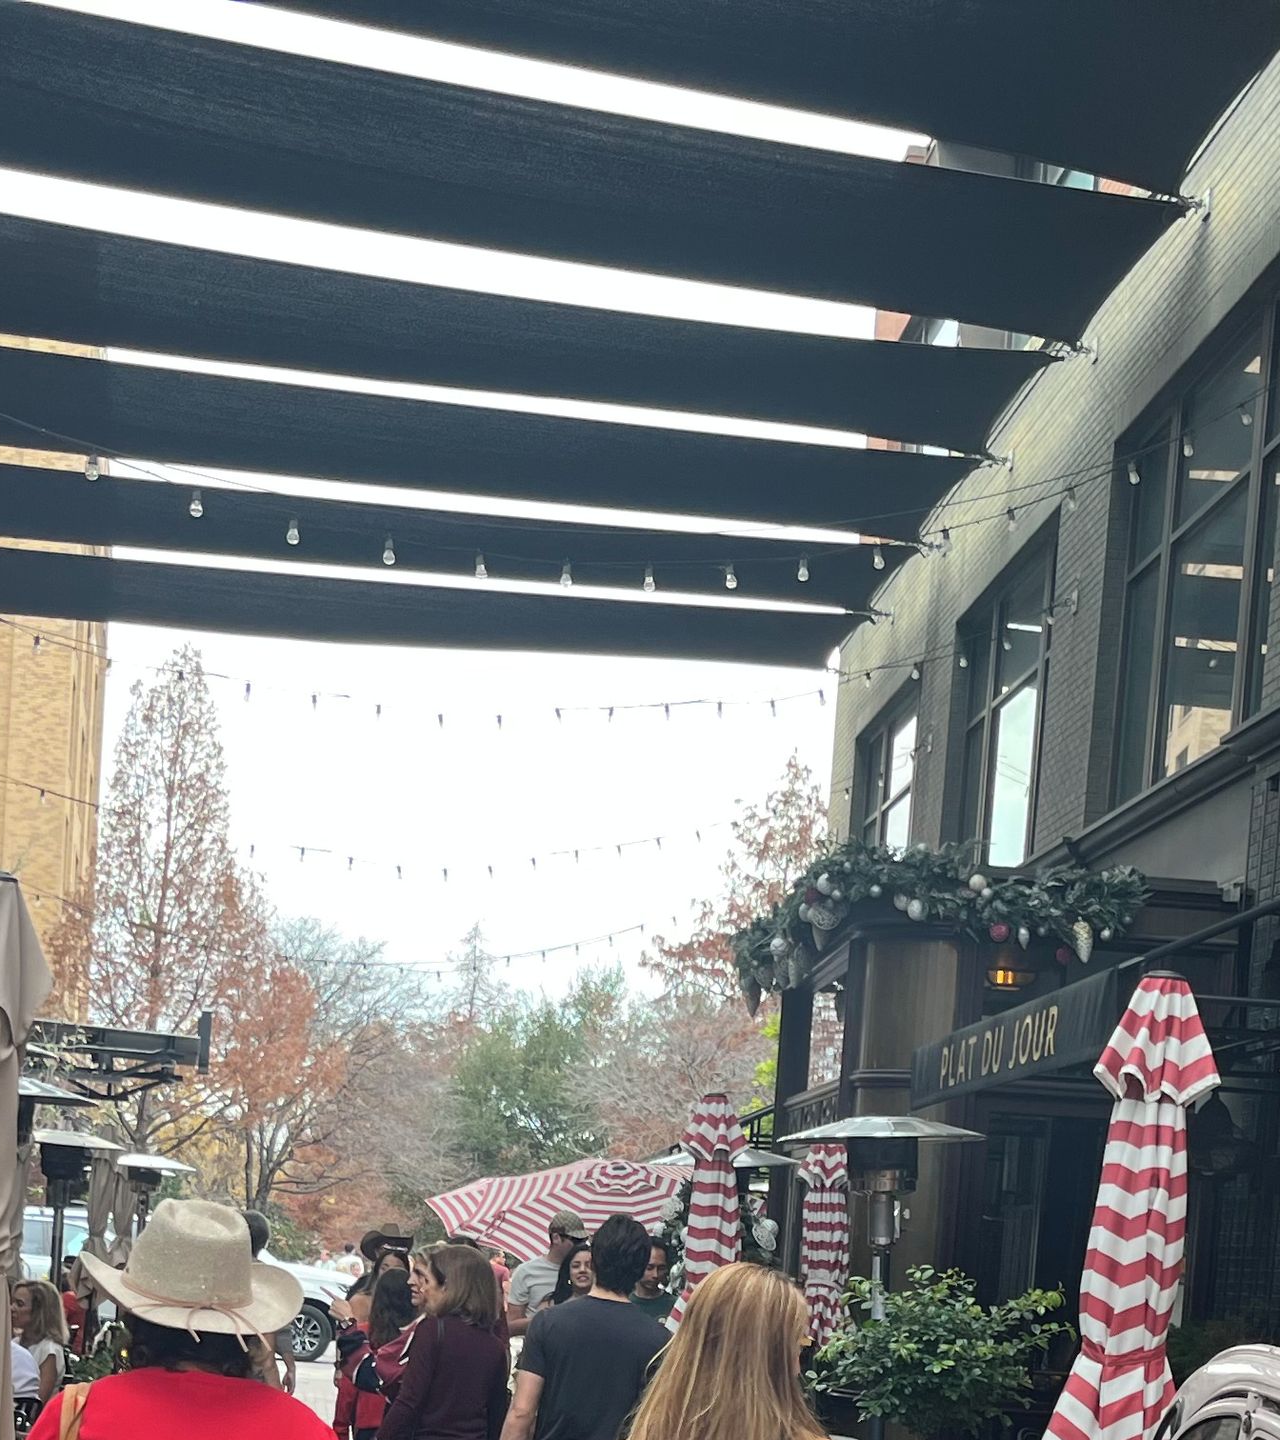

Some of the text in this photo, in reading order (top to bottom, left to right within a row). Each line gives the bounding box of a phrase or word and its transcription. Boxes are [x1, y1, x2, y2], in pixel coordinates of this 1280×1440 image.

[940, 1005, 1058, 1089] PLAT DU JOUR
